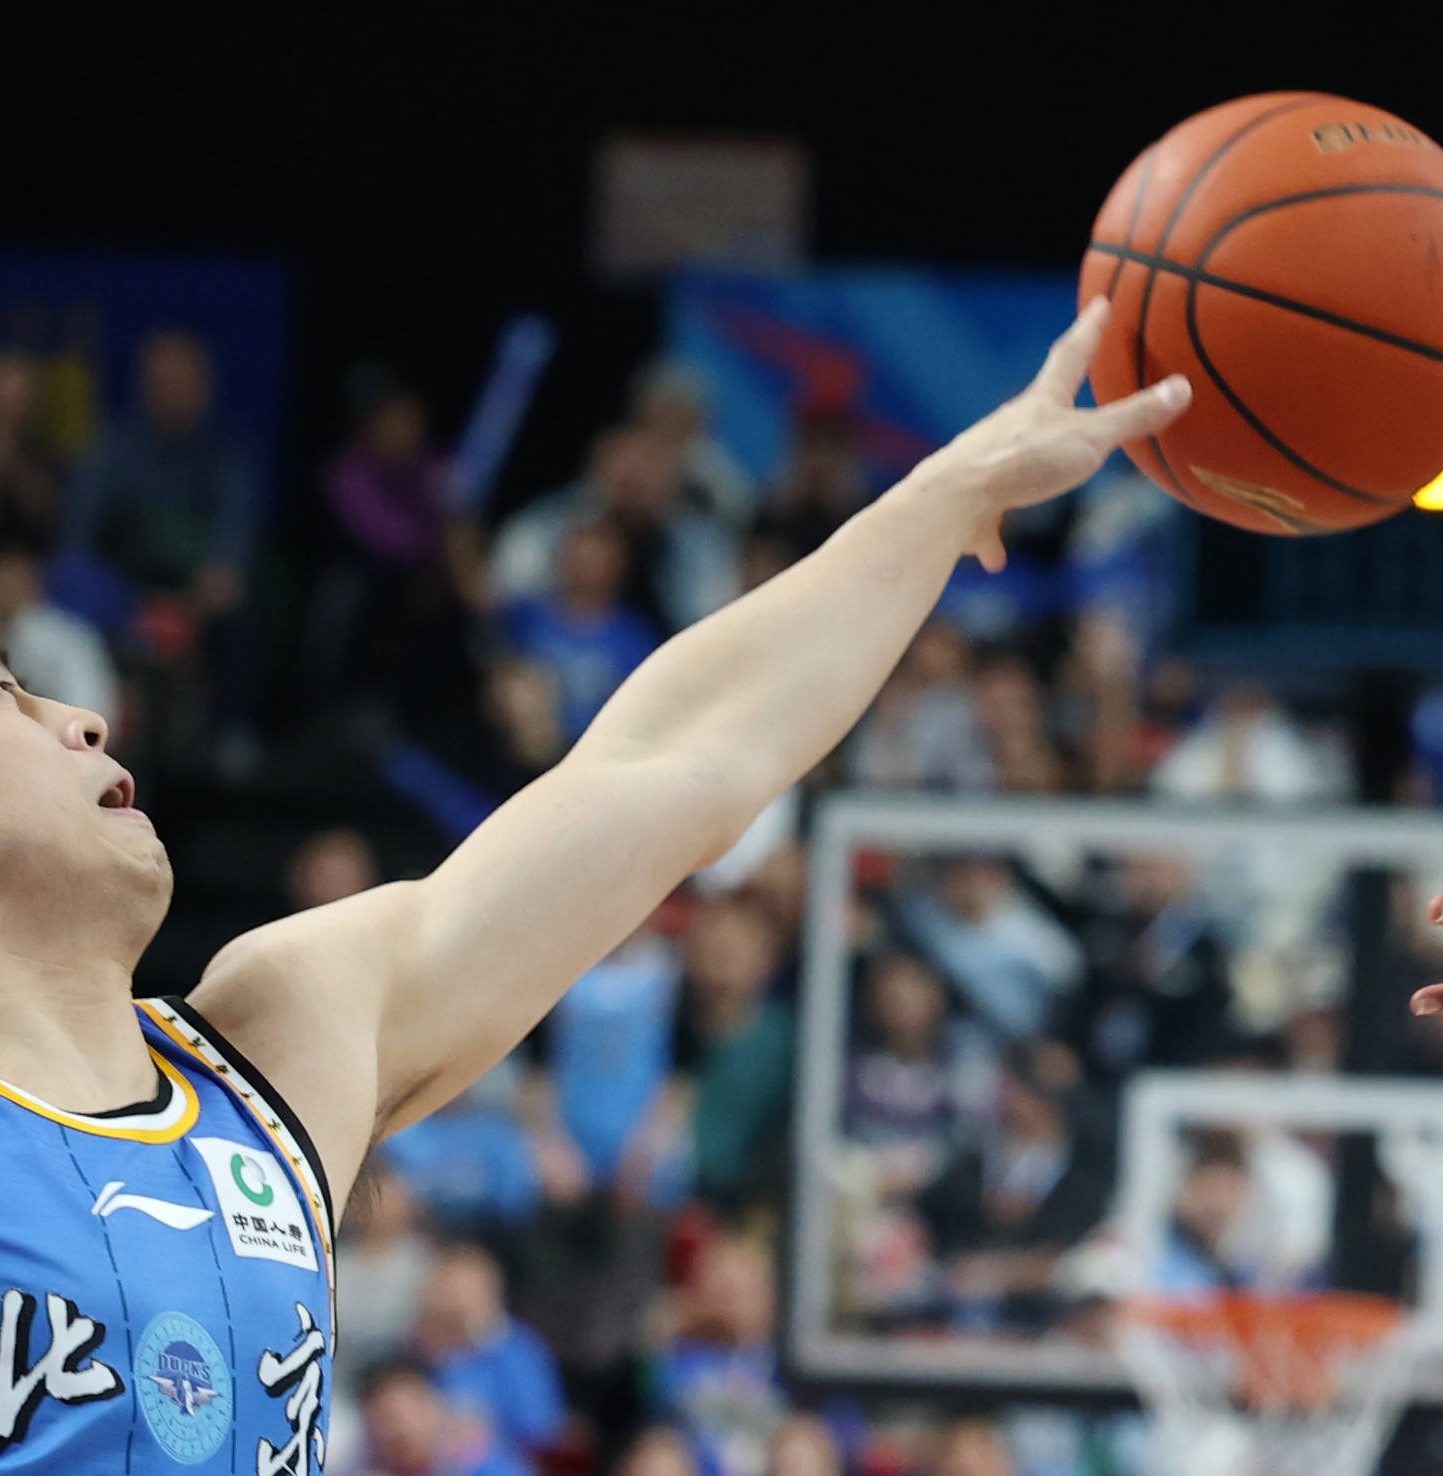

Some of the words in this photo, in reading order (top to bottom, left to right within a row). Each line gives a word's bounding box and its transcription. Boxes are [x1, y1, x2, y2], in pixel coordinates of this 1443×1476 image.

[232, 1212, 303, 1241] 中国人寿
[239, 1234, 279, 1249] CHINA
[282, 1242, 308, 1257] LIFE
[158, 1352, 212, 1384] DUCKS
